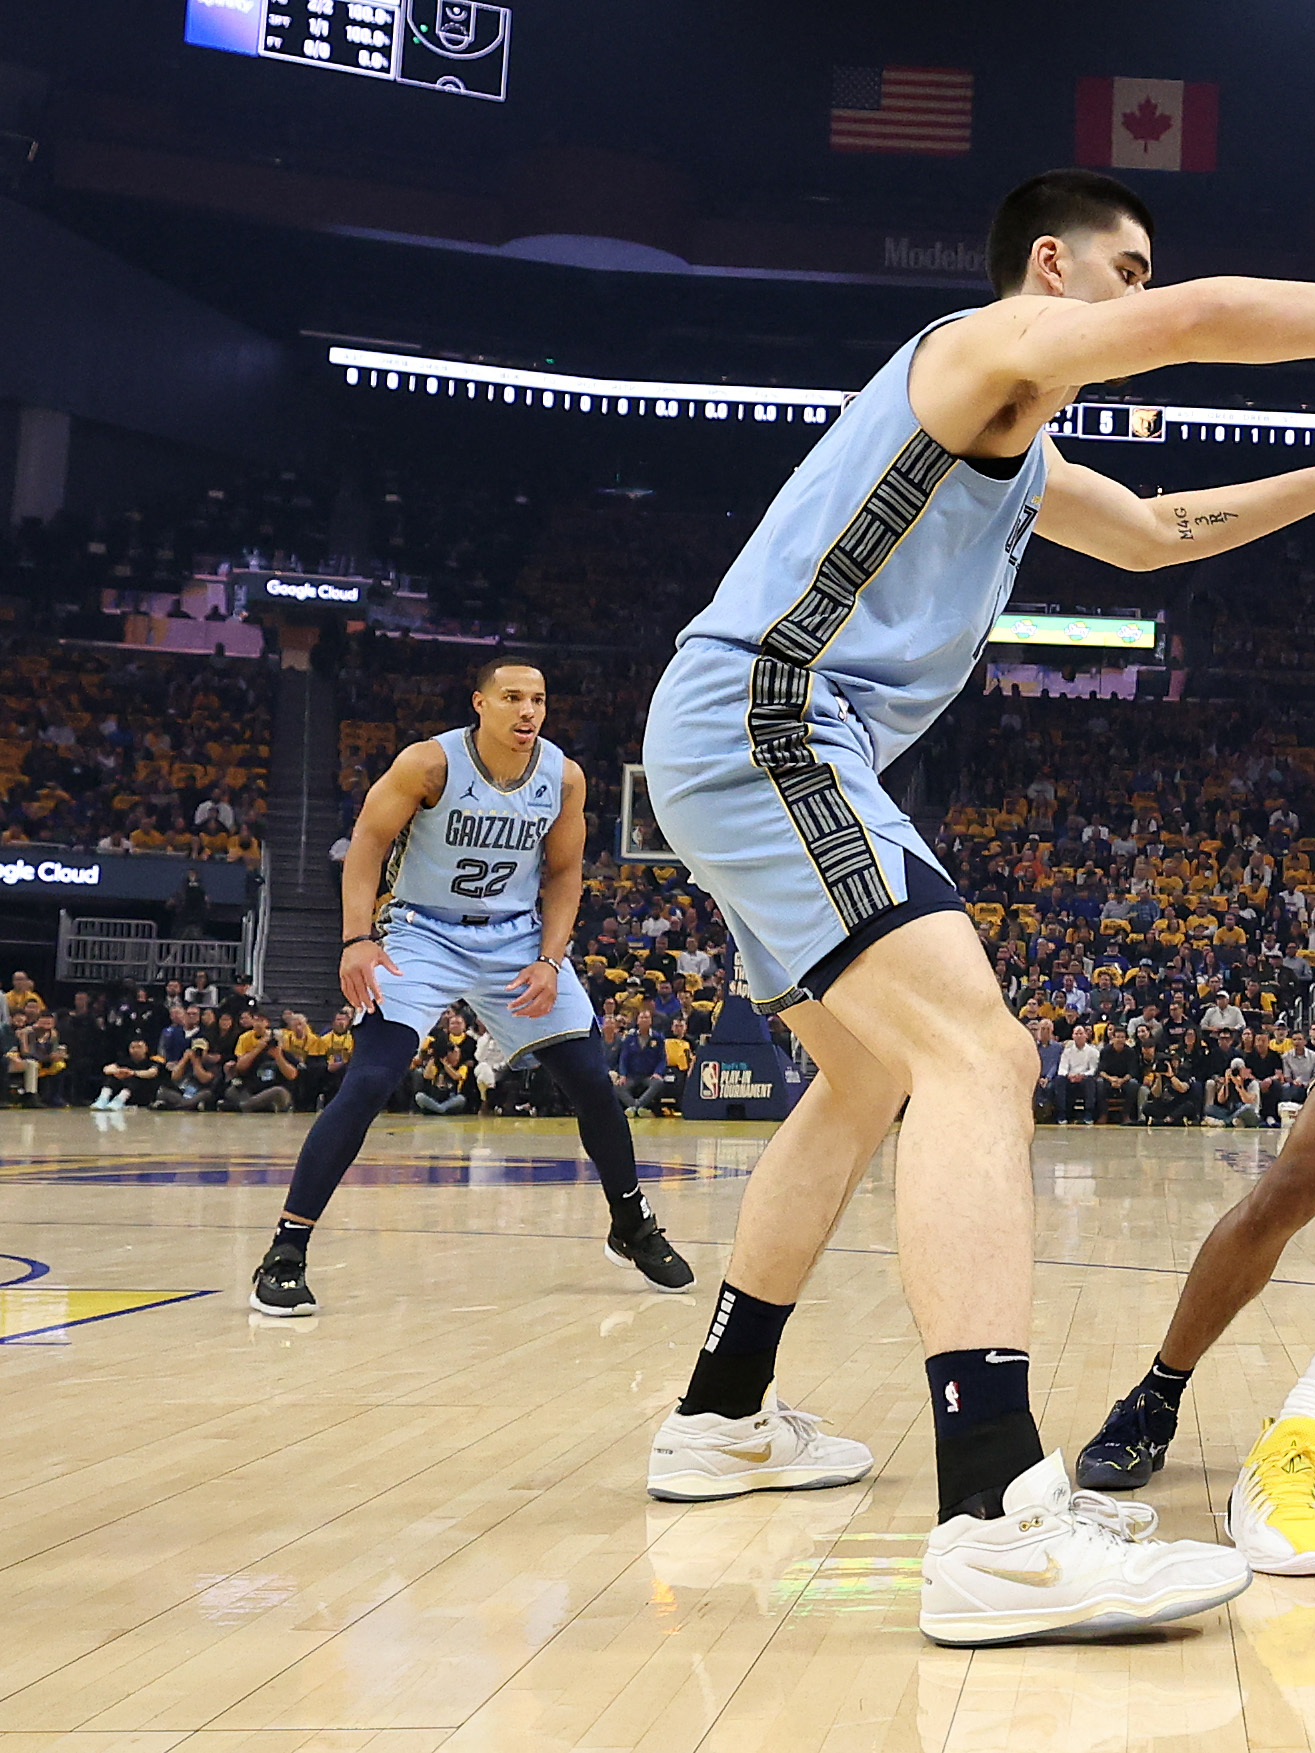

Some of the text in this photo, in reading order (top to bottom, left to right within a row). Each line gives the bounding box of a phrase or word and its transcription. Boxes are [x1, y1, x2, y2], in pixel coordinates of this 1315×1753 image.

[885, 237, 978, 272] Modelo
[347, 368, 826, 423] 0 0 0 1 0 0 0 0 0.0 0.0 0.0 0.0
[1099, 410, 1113, 434] 5
[1181, 425, 1188, 439] 1
[1215, 426, 1224, 441] 0
[1252, 428, 1258, 442] 1
[1285, 430, 1294, 444] 0
[1173, 507, 1194, 541] M4G
[266, 579, 317, 600] Google
[318, 584, 358, 601] Cloud
[445, 809, 548, 851] GRIZZLIES
[37, 861, 99, 884] Cloud
[451, 858, 518, 898] 22
[720, 1083, 772, 1098] TOURNAMENT
